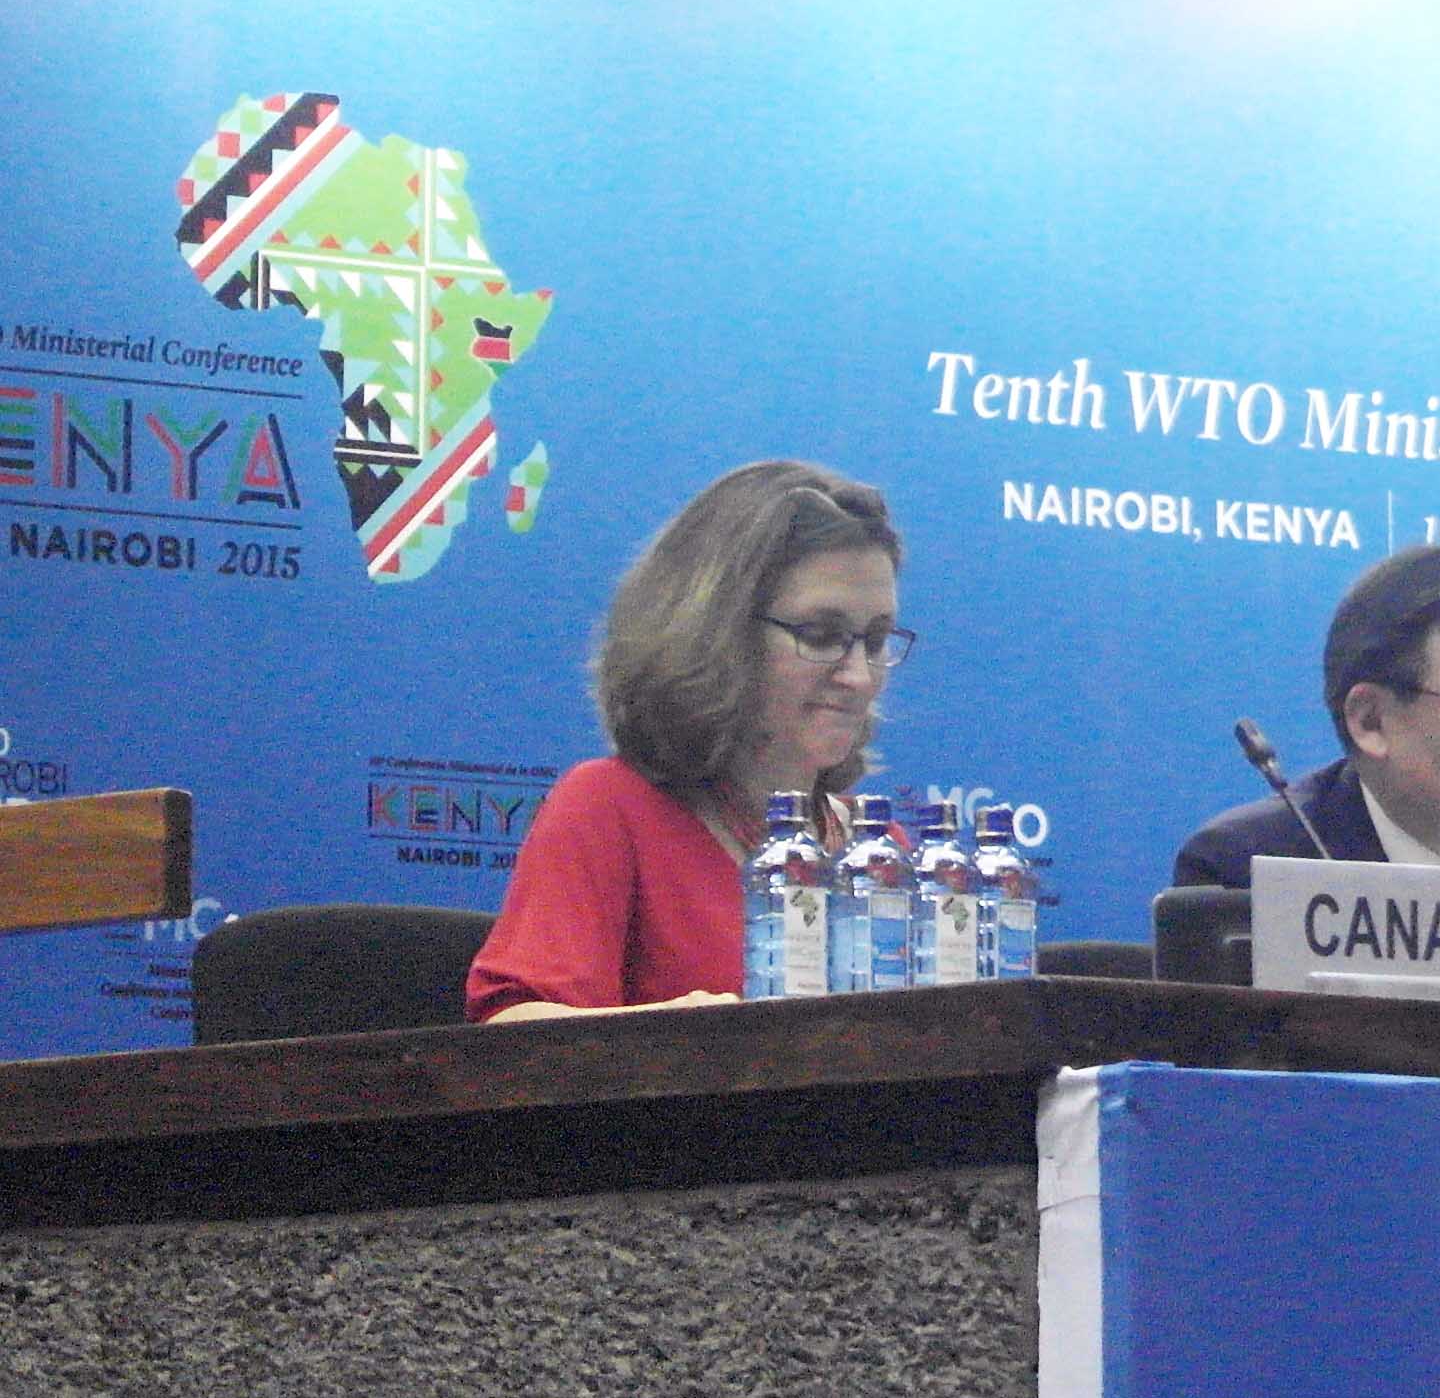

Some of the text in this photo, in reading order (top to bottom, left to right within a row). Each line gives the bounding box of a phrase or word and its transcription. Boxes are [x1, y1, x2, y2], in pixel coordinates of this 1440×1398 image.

[10, 324, 154, 364] Ministerial
[161, 339, 304, 378] Conference
[927, 351, 1106, 430] Tenth
[1124, 369, 1287, 446] WTO
[1002, 479, 1203, 545] NAIROBI,
[1215, 499, 1361, 551] KENYA
[9, 521, 303, 581] NAIROBI 2015
[397, 845, 482, 868] NAIROBI
